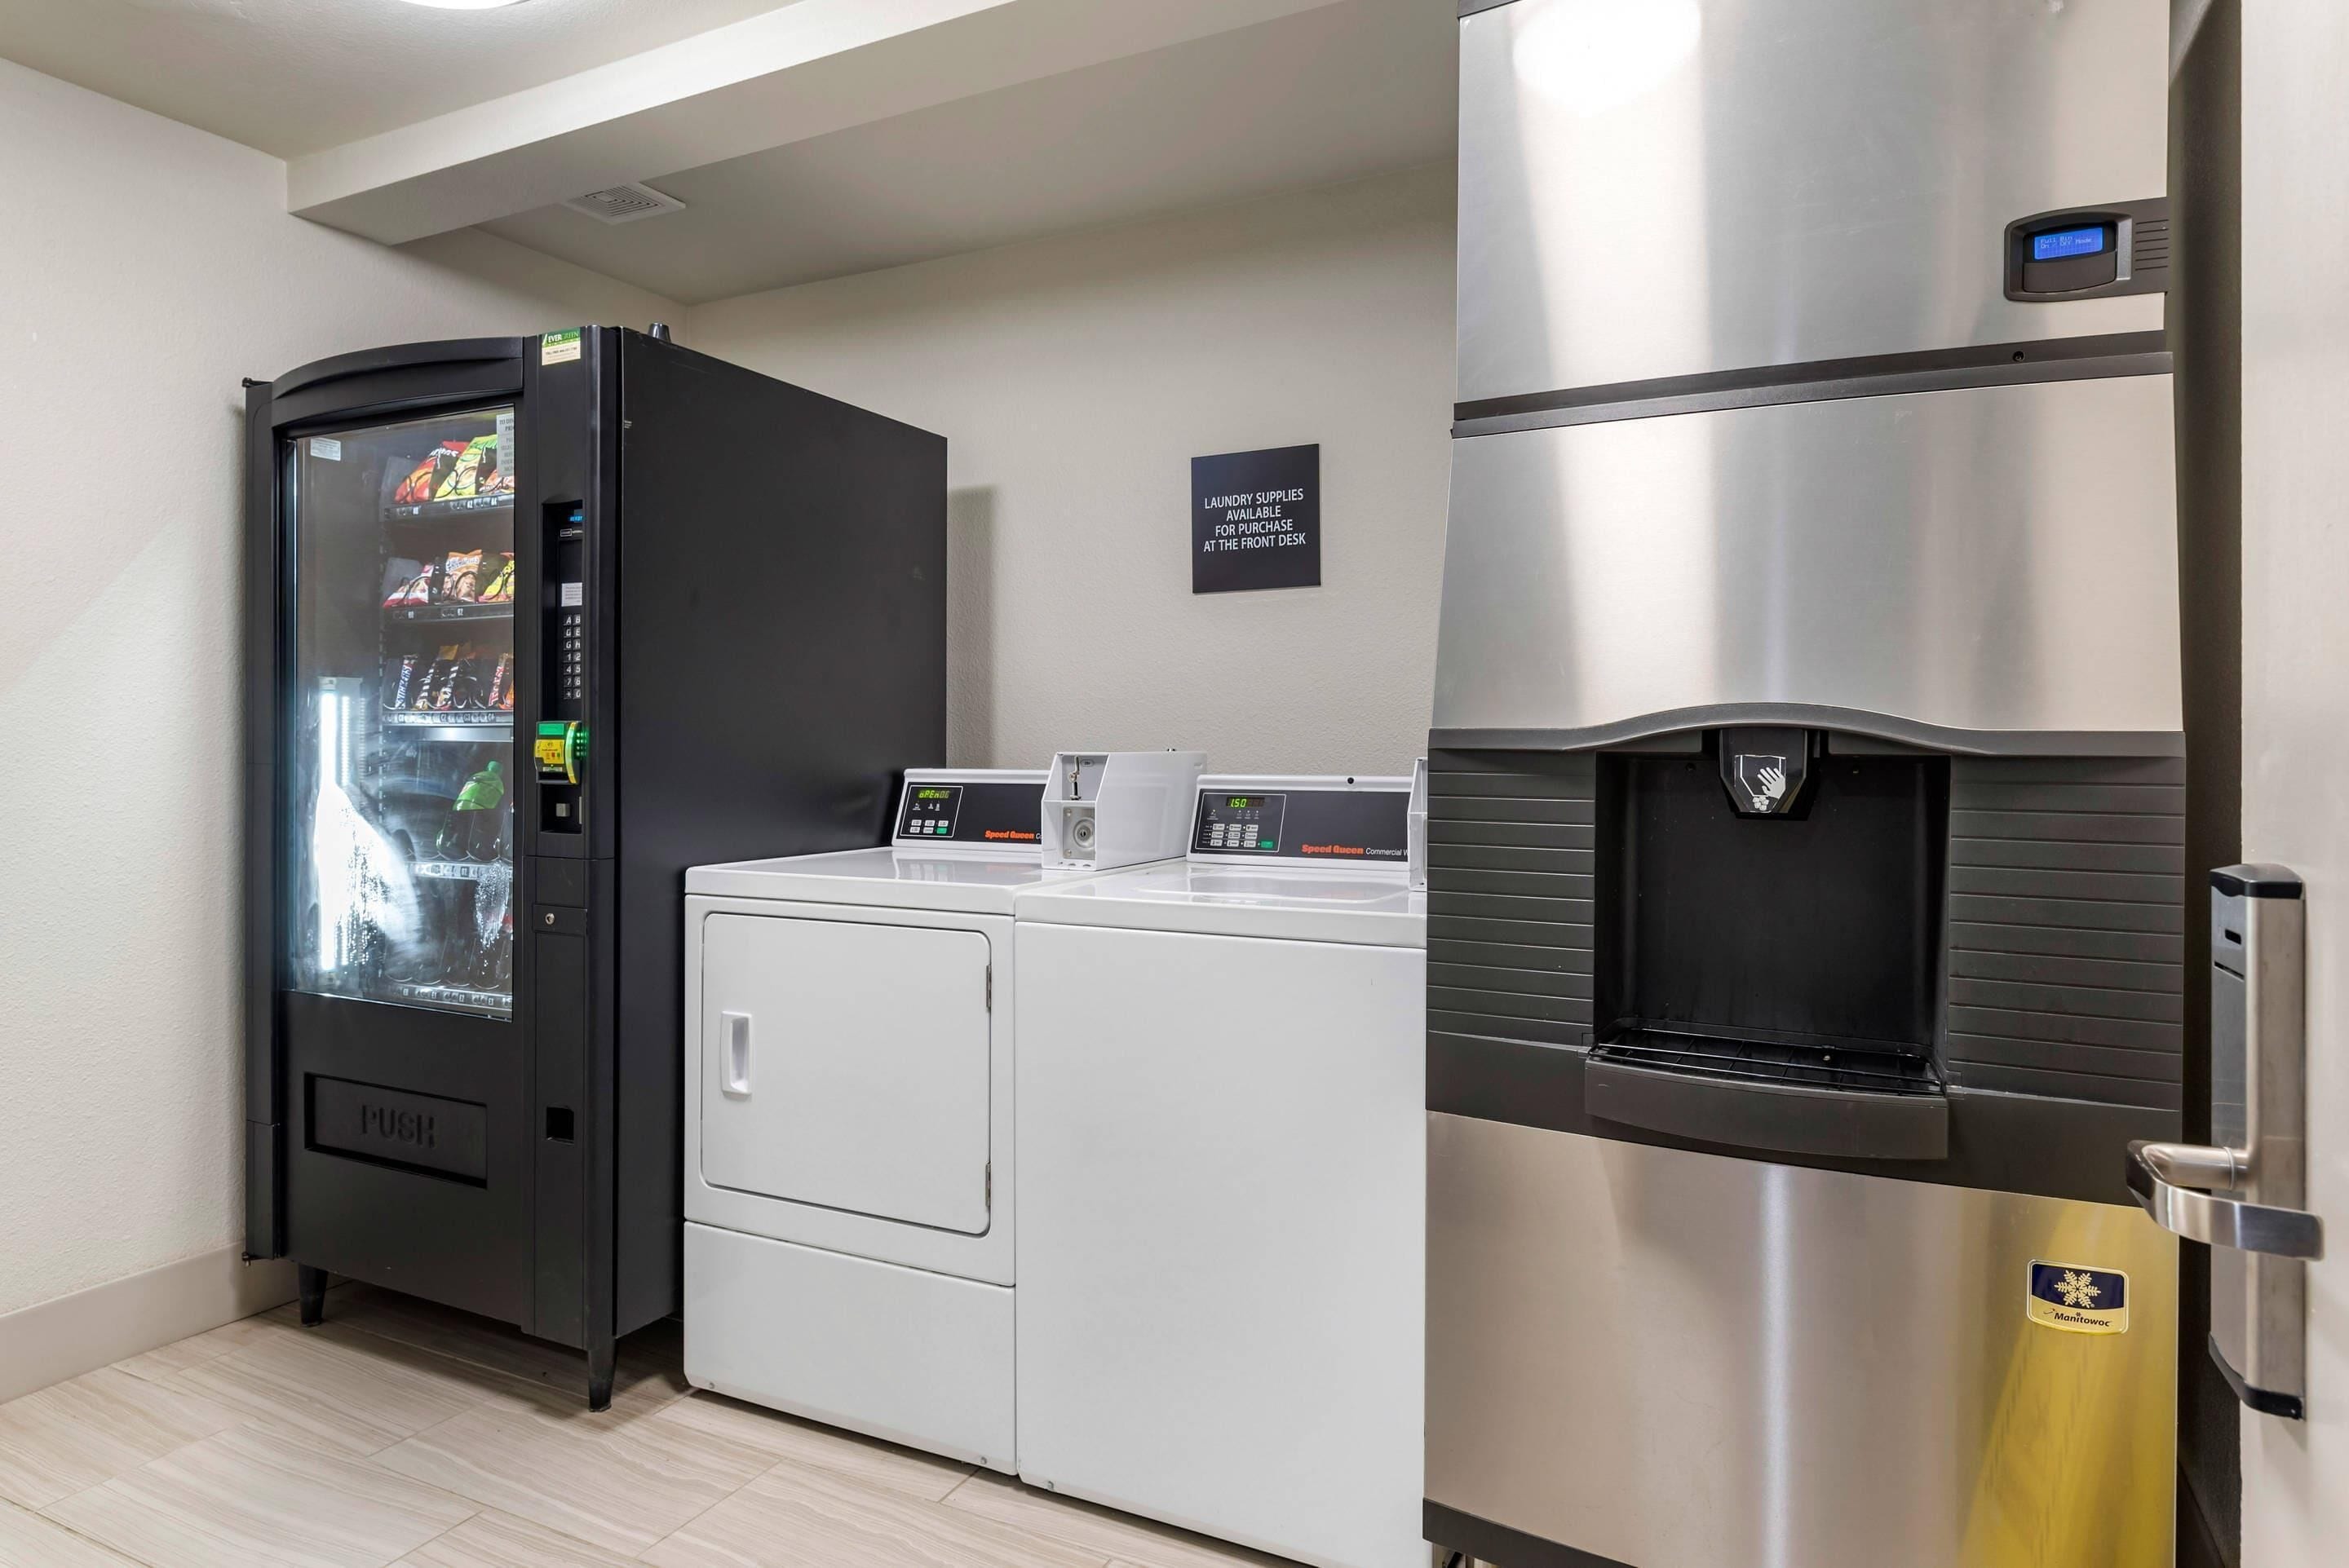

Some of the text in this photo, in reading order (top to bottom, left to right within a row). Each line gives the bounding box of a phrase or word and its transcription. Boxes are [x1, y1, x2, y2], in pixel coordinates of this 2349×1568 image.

[1205, 488, 1303, 509] LAUNDRY SUPPLIES
[1227, 506, 1281, 521] AVAILABLE
[1215, 519, 1294, 537] FOR PURCHASE
[1203, 532, 1306, 552] AT THE FRONT DESK
[985, 830, 1009, 839] Speed
[1010, 831, 1034, 840] Queen
[1302, 844, 1332, 854] Speed
[1333, 845, 1364, 855] Queen
[1365, 847, 1402, 856] Commercial
[361, 1104, 436, 1149] PUSH
[2054, 1312, 2112, 1327] Manitowoc
